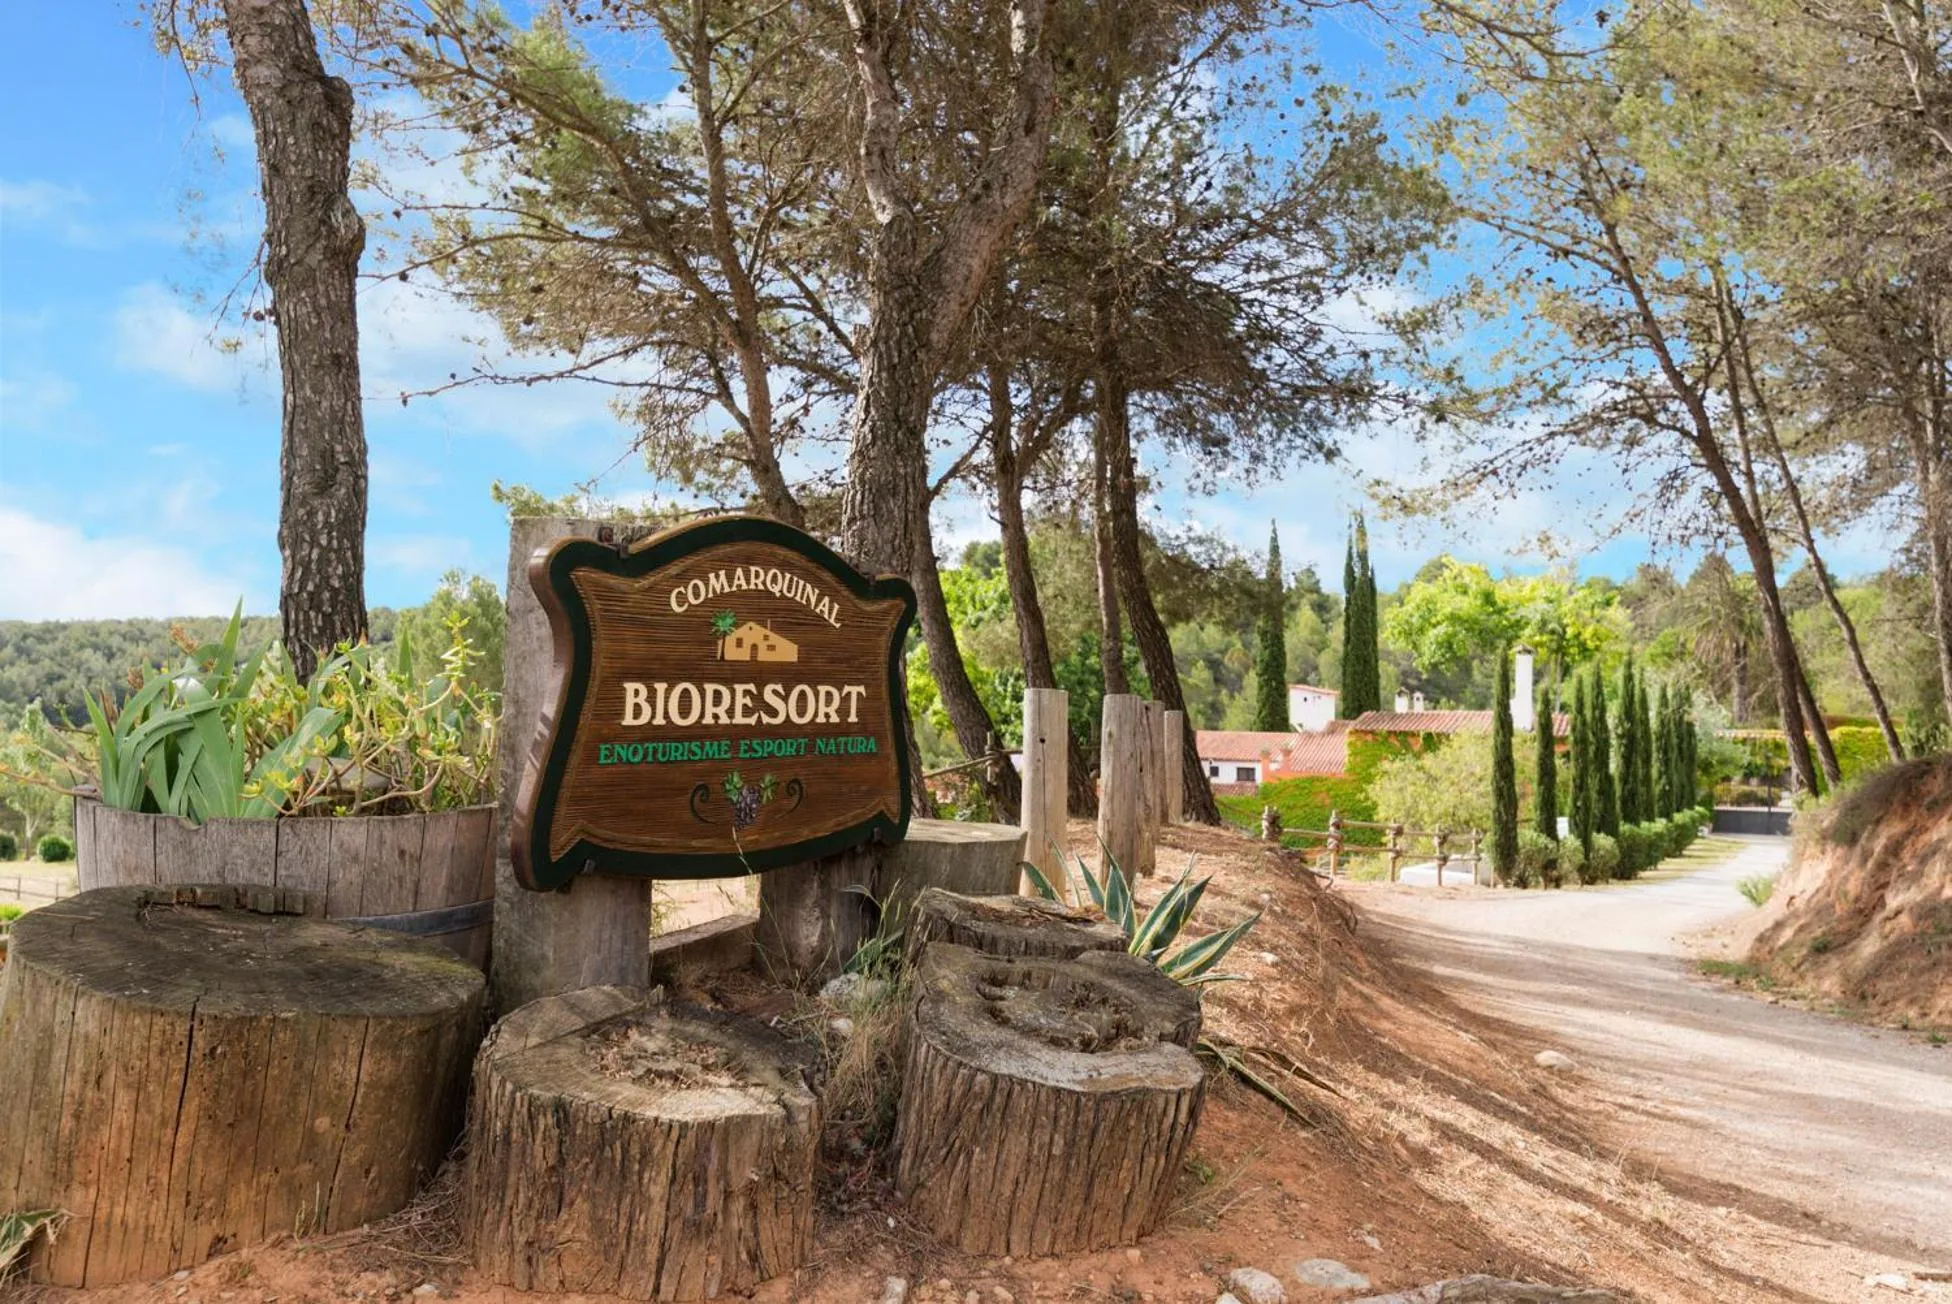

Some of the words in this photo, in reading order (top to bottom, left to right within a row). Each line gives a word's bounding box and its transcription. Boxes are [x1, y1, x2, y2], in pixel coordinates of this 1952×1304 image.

[670, 566, 842, 629] COMARQUINAL
[621, 681, 866, 727] BIORESORT
[598, 740, 732, 766] ENOTURISME
[738, 738, 809, 760] ESPORT
[815, 736, 878, 756] NATURA
